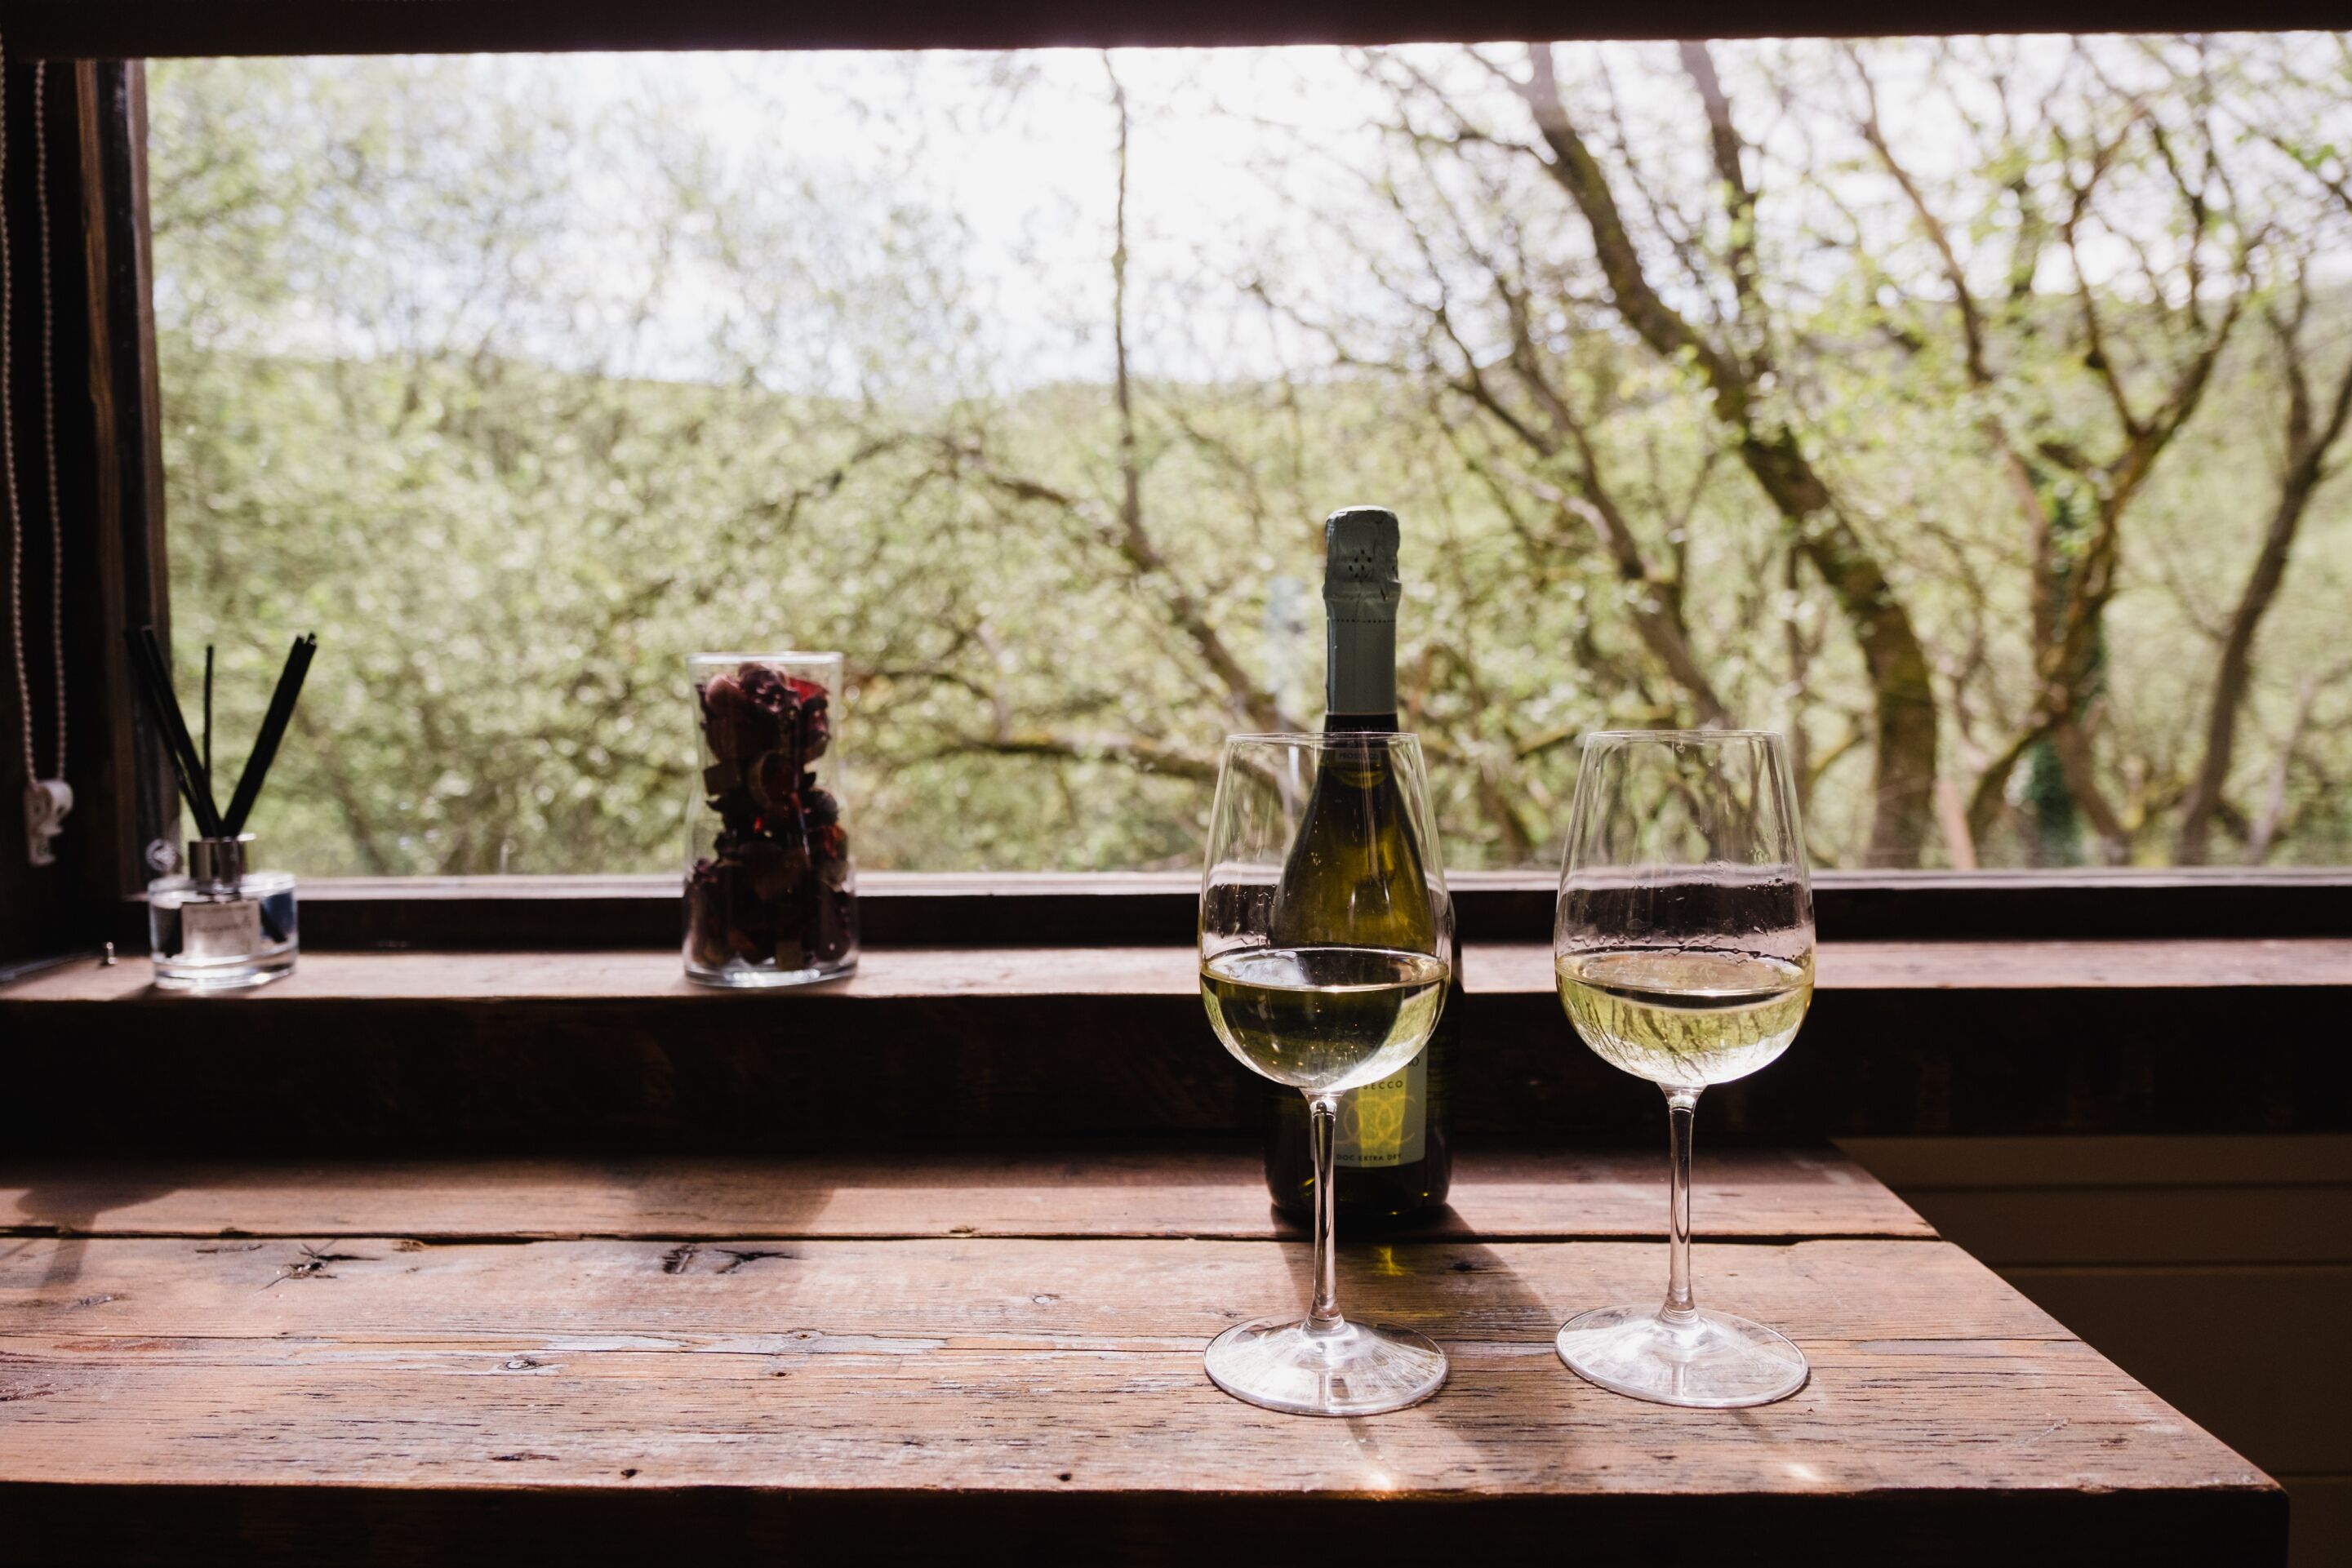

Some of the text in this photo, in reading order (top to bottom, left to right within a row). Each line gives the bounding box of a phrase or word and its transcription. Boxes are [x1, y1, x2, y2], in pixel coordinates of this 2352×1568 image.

[1338, 752, 1379, 760] PROSCO
[1354, 1080, 1403, 1090] SECCO
[1336, 1153, 1403, 1162] DOC EXTRA DRY
